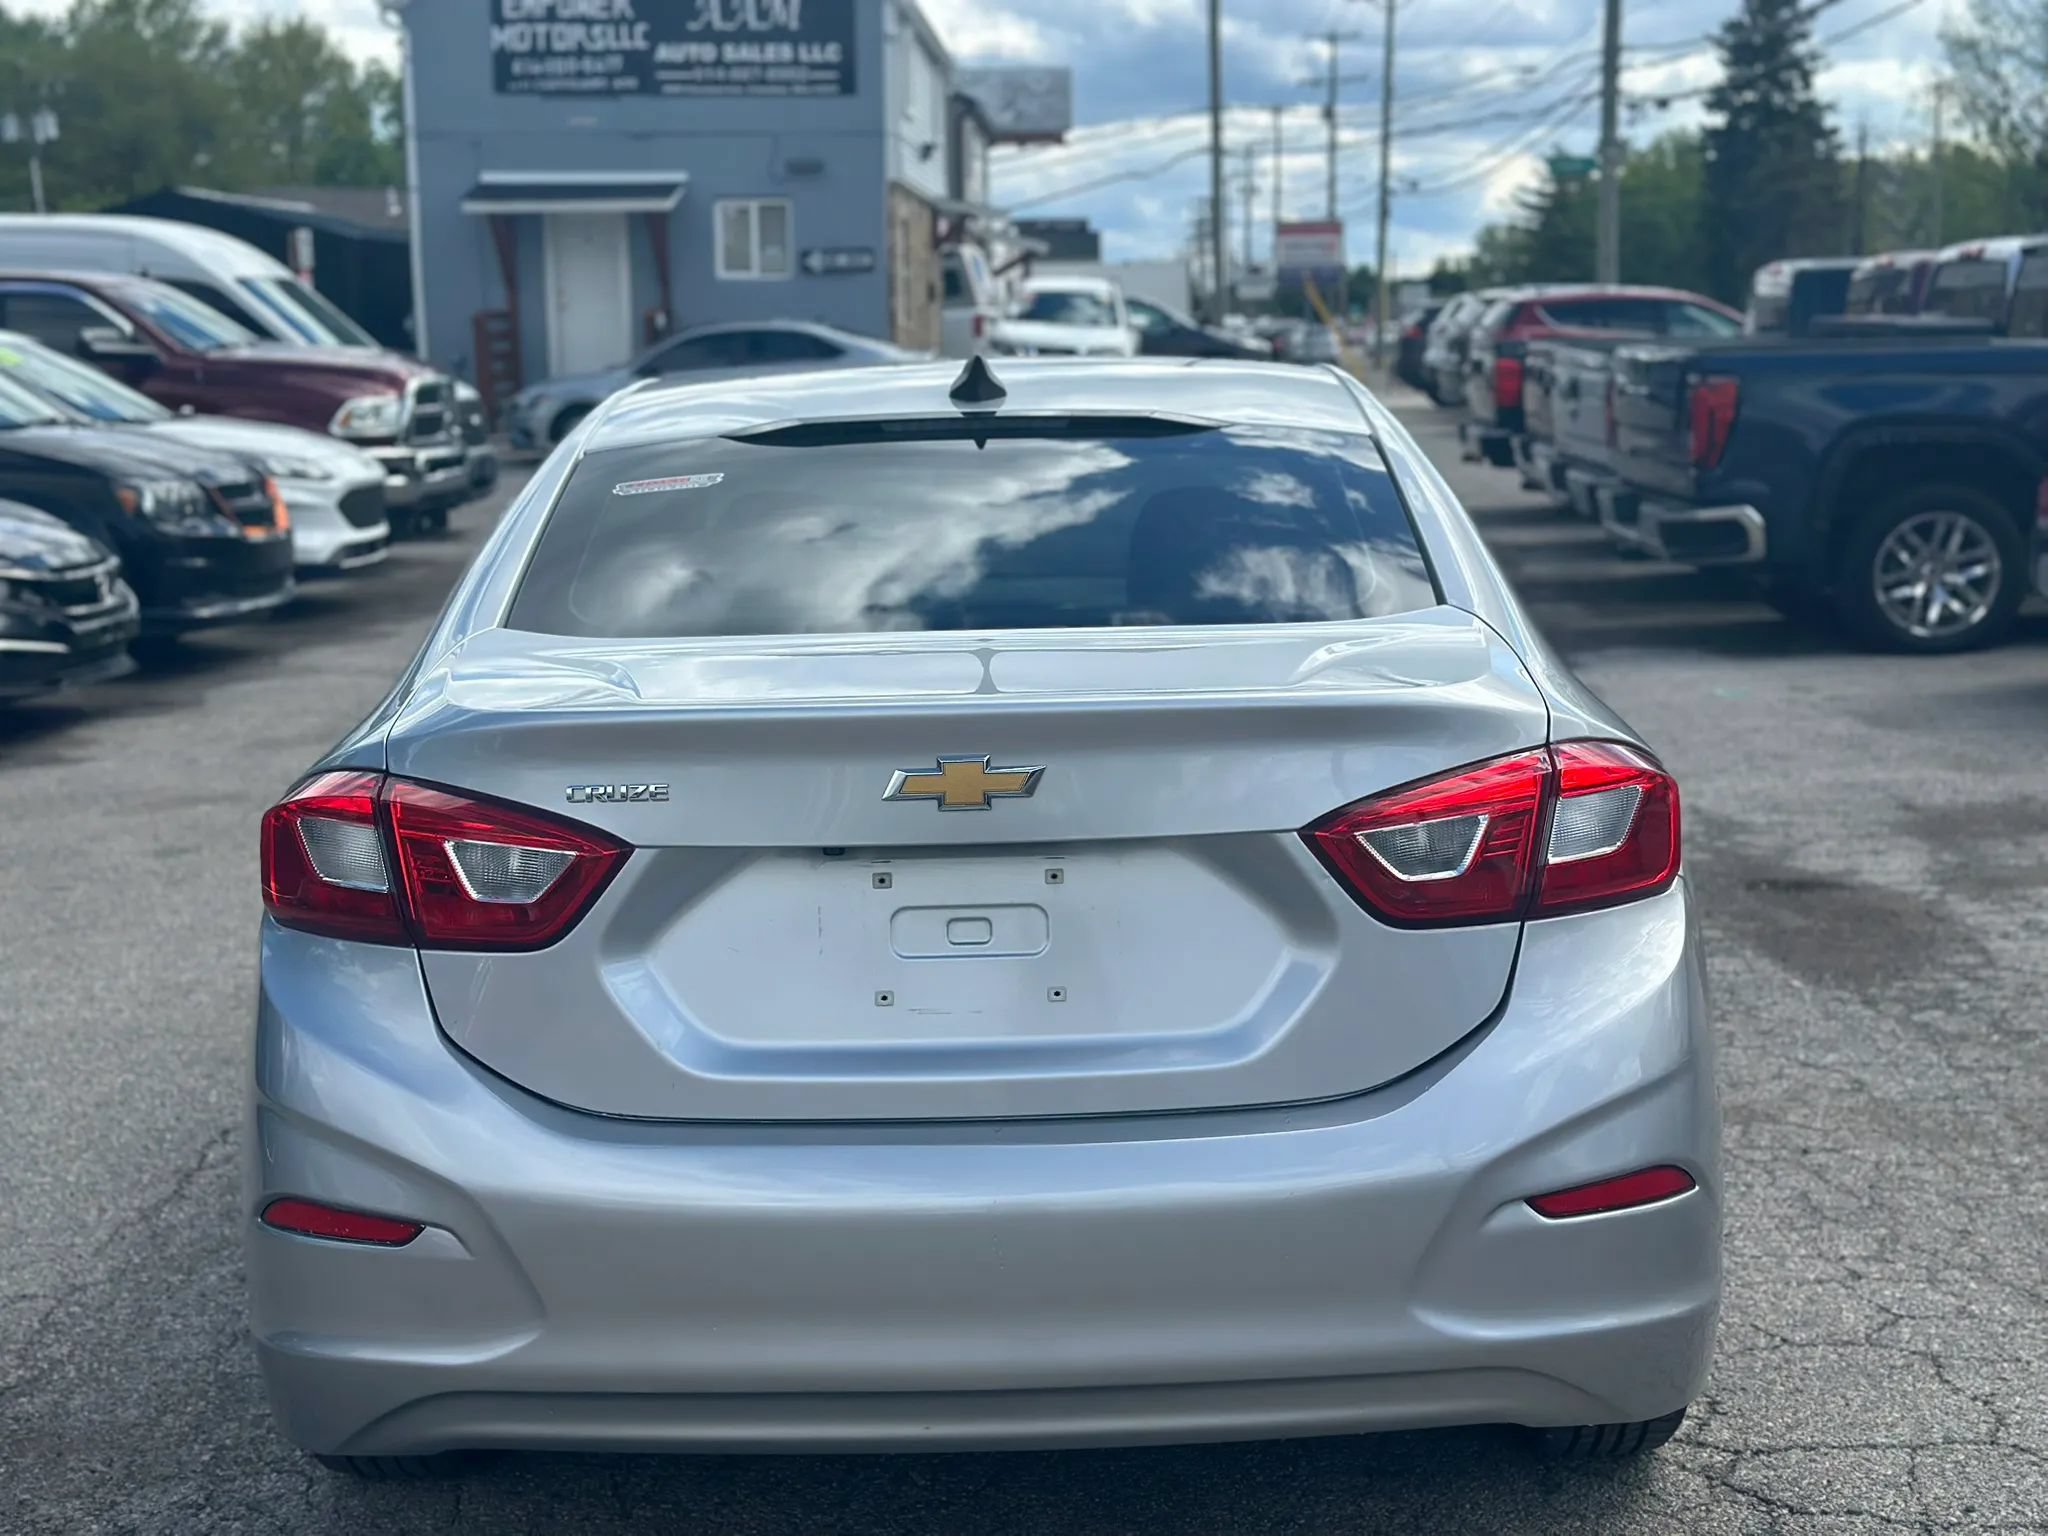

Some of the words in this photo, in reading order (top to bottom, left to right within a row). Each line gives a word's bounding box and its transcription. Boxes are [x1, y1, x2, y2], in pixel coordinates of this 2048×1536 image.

[654, 41, 719, 63] AUTO
[721, 41, 794, 63] SALES
[798, 41, 842, 63] LLC
[565, 783, 669, 803] CRUZE
